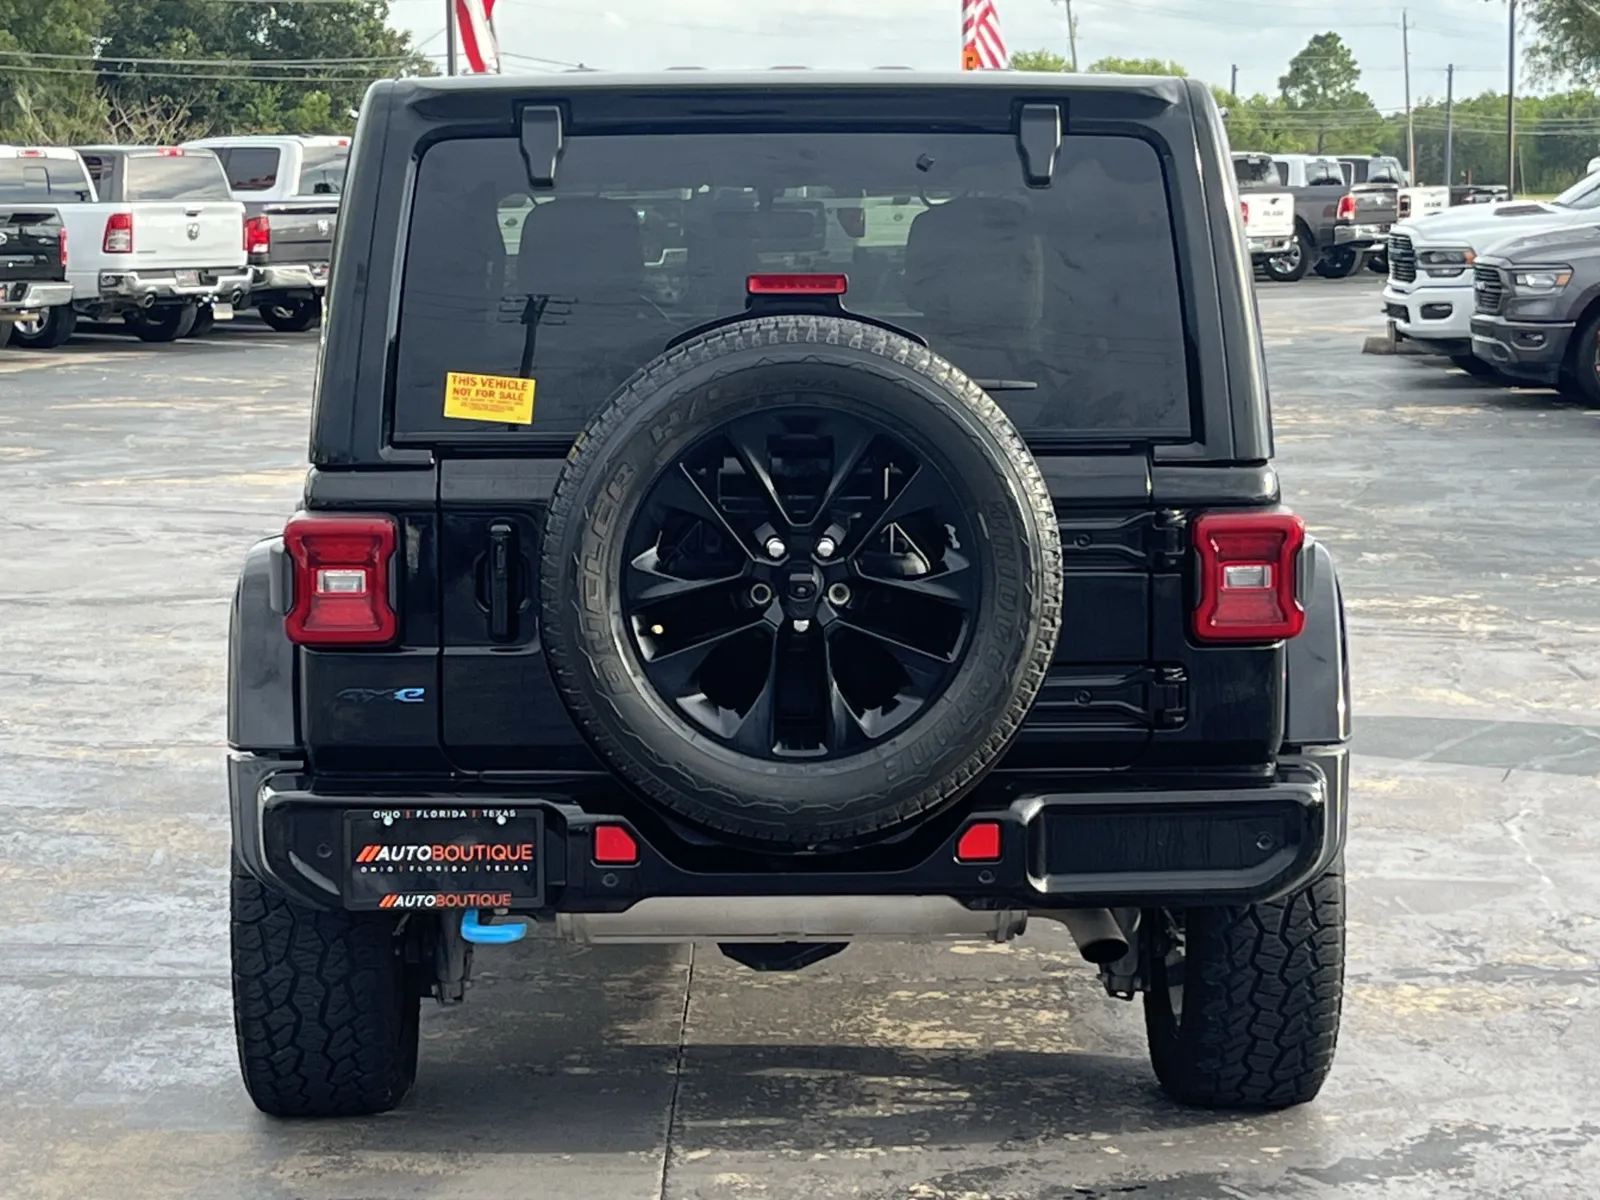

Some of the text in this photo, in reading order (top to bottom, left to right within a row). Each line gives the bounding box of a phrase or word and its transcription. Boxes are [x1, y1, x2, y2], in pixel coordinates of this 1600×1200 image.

[452, 375, 528, 391] THIS VEHICLE
[453, 387, 472, 396] NOT
[475, 389, 495, 398] FOR
[499, 392, 524, 401] SALE
[373, 810, 516, 819] OHIO FLORIDA TEXAS
[375, 844, 534, 862] AUTOBOUTIQUE
[394, 894, 512, 907] AUTOBOUTIQUE
